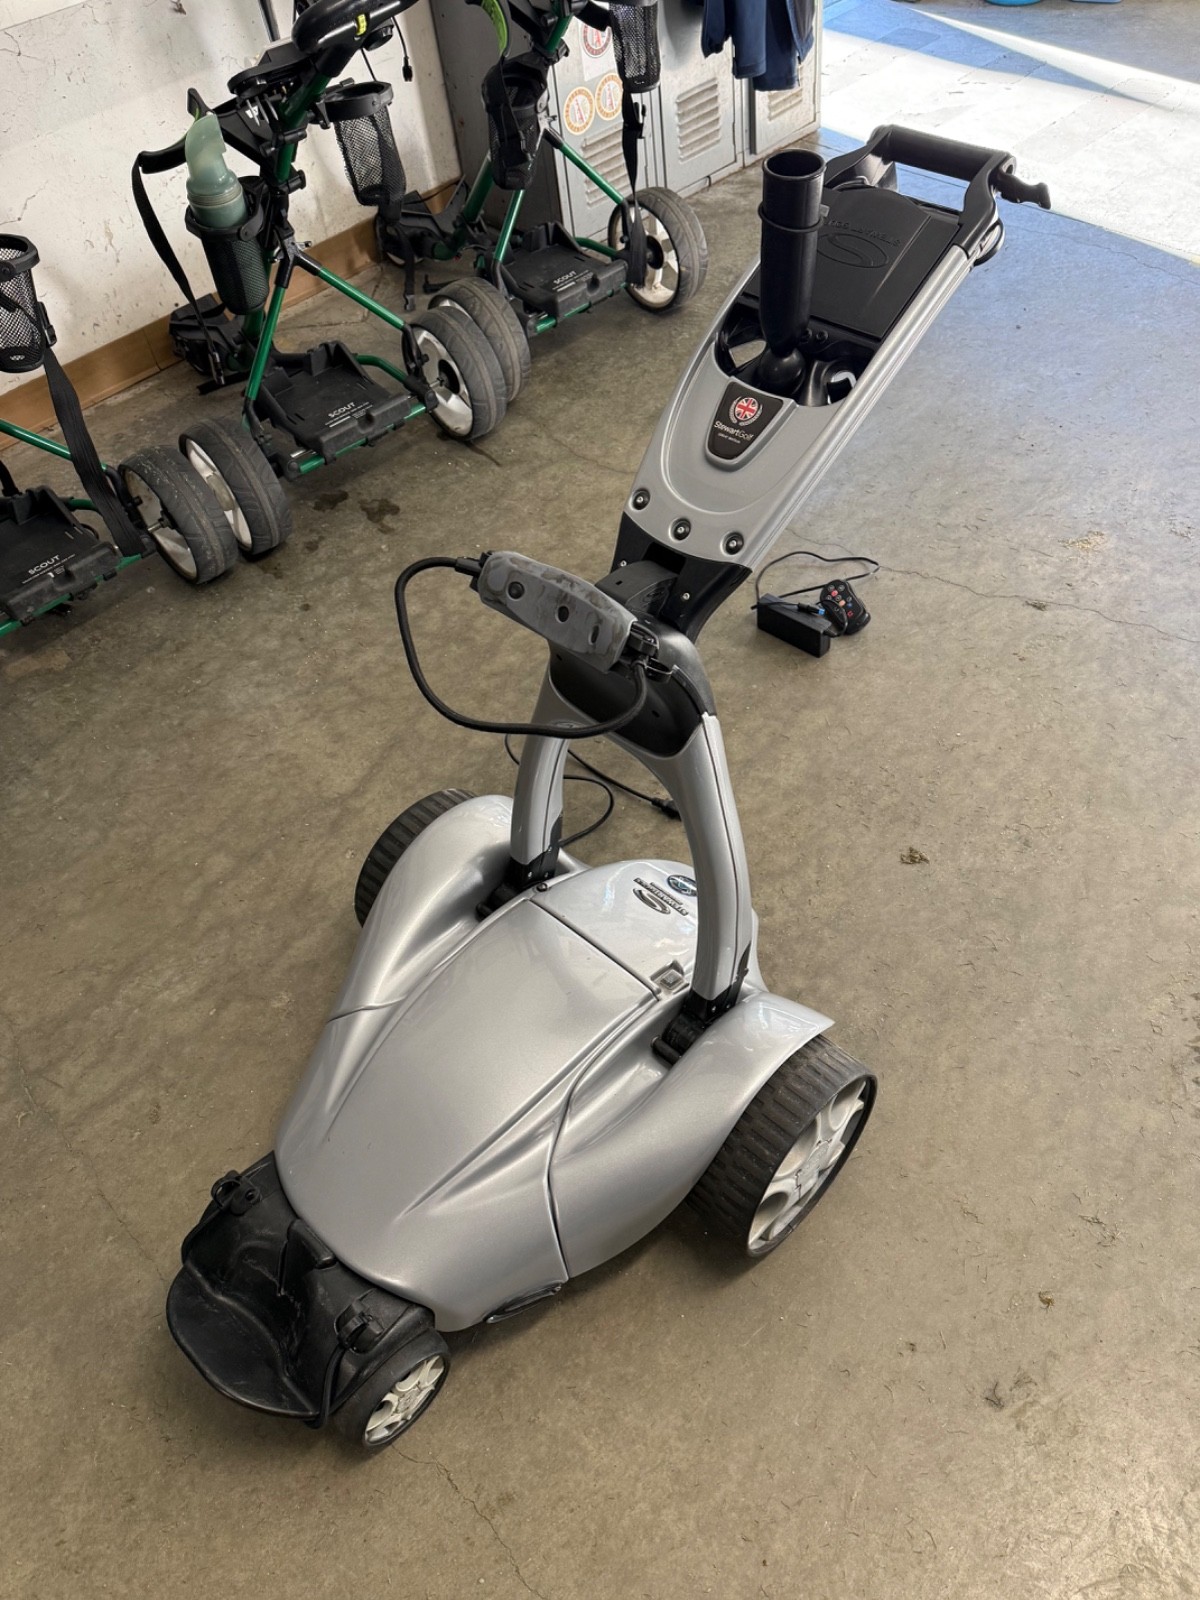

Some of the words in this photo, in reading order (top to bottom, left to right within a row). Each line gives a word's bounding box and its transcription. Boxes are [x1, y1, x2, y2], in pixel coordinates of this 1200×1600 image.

[553, 270, 577, 285] SCOUT
[328, 402, 356, 418] SCOUT
[28, 554, 61, 575] SCOUT
